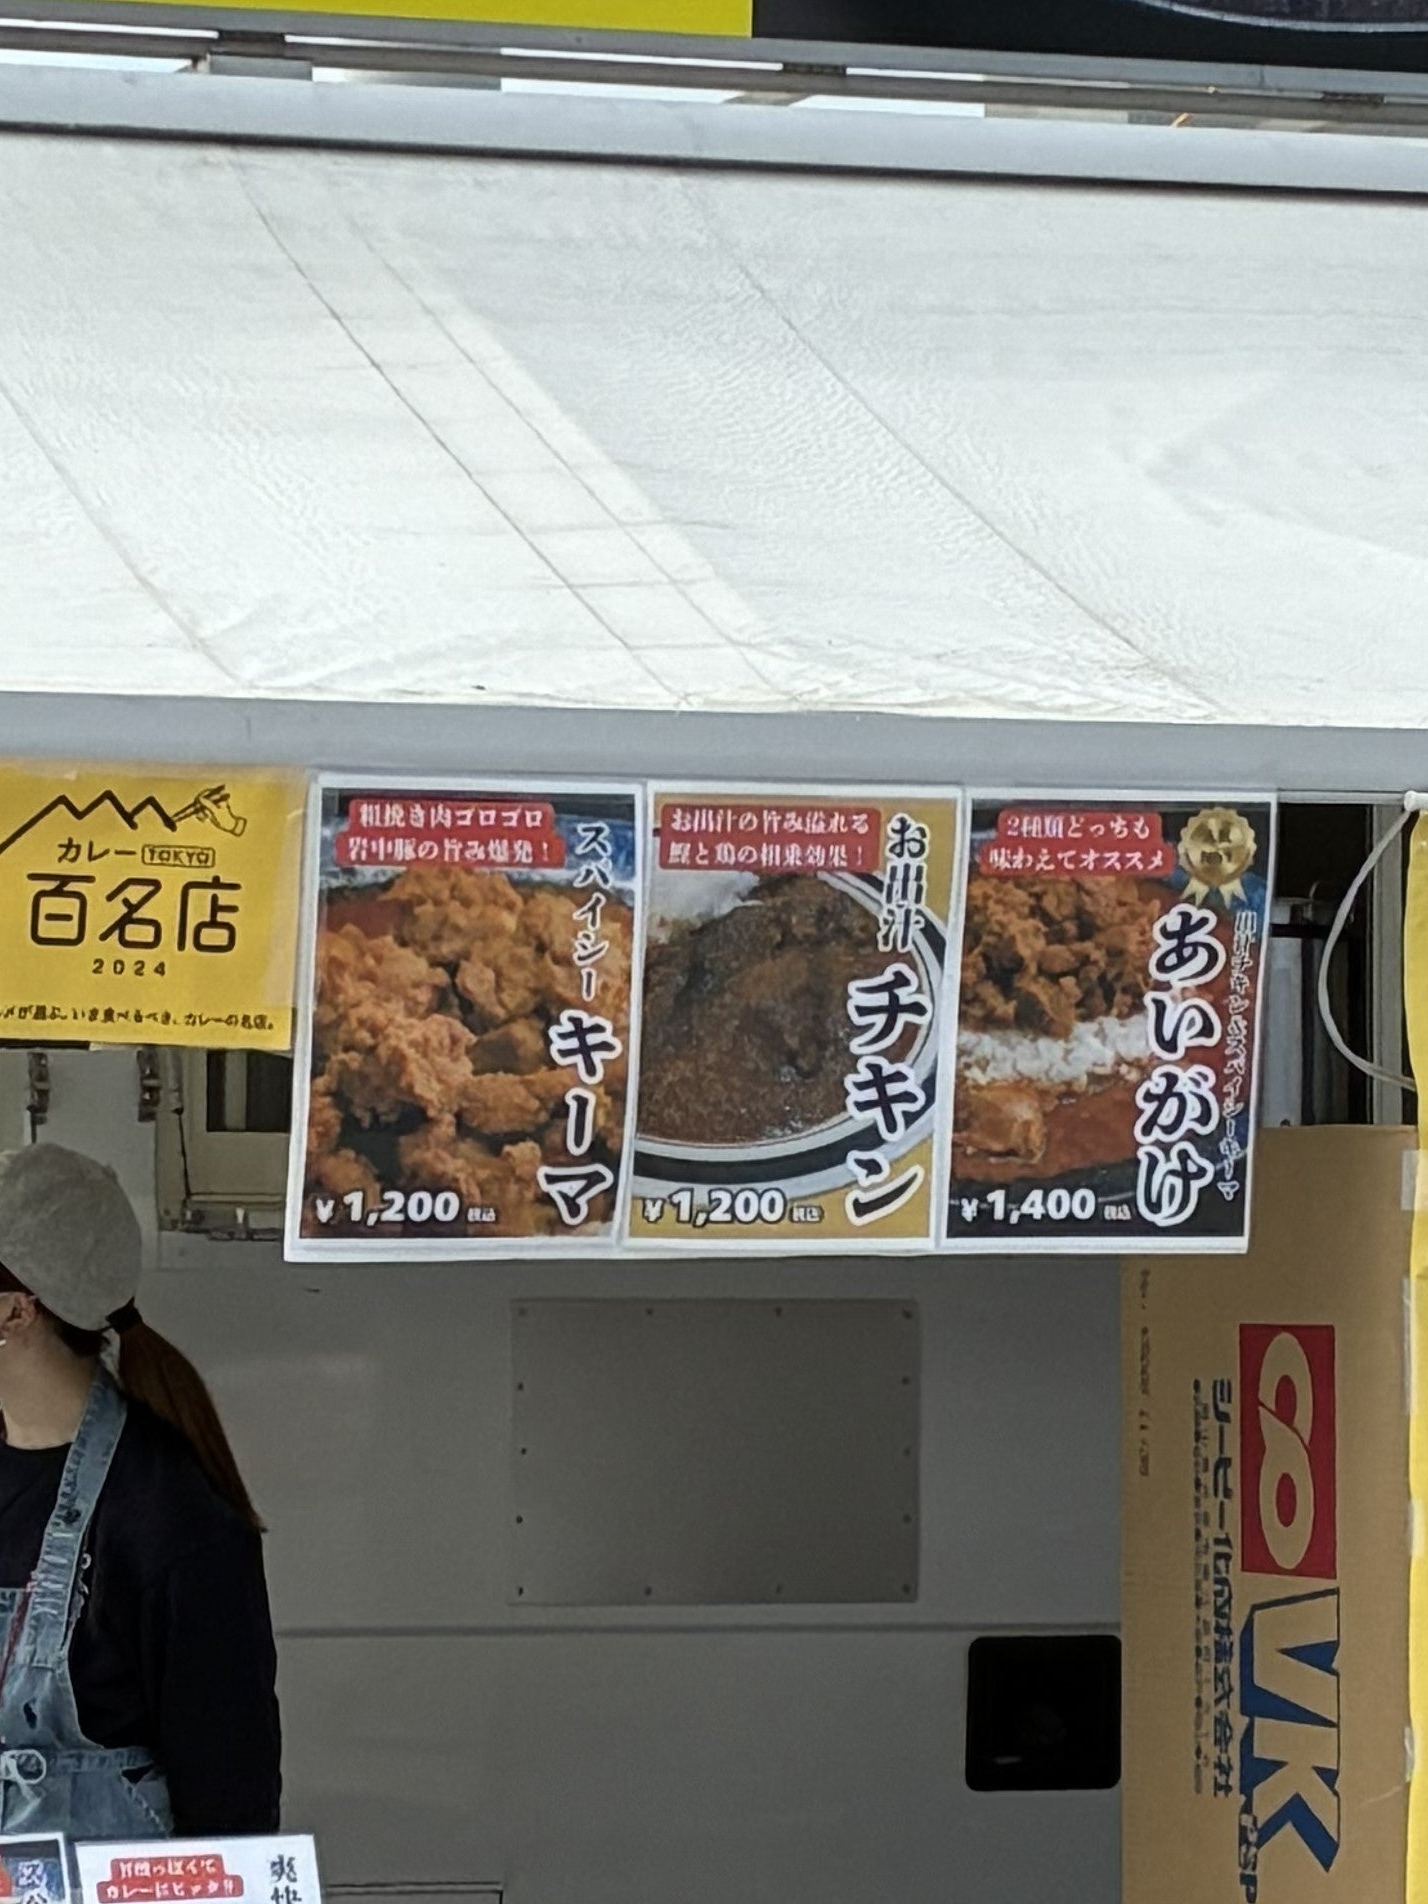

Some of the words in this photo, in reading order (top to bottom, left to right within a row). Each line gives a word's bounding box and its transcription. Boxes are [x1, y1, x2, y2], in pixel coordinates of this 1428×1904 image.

[57, 836, 137, 864] カレー
[26, 873, 242, 954] 百名店
[92, 958, 166, 977] 2024
[1134, 902, 1227, 1228] あいがけ
